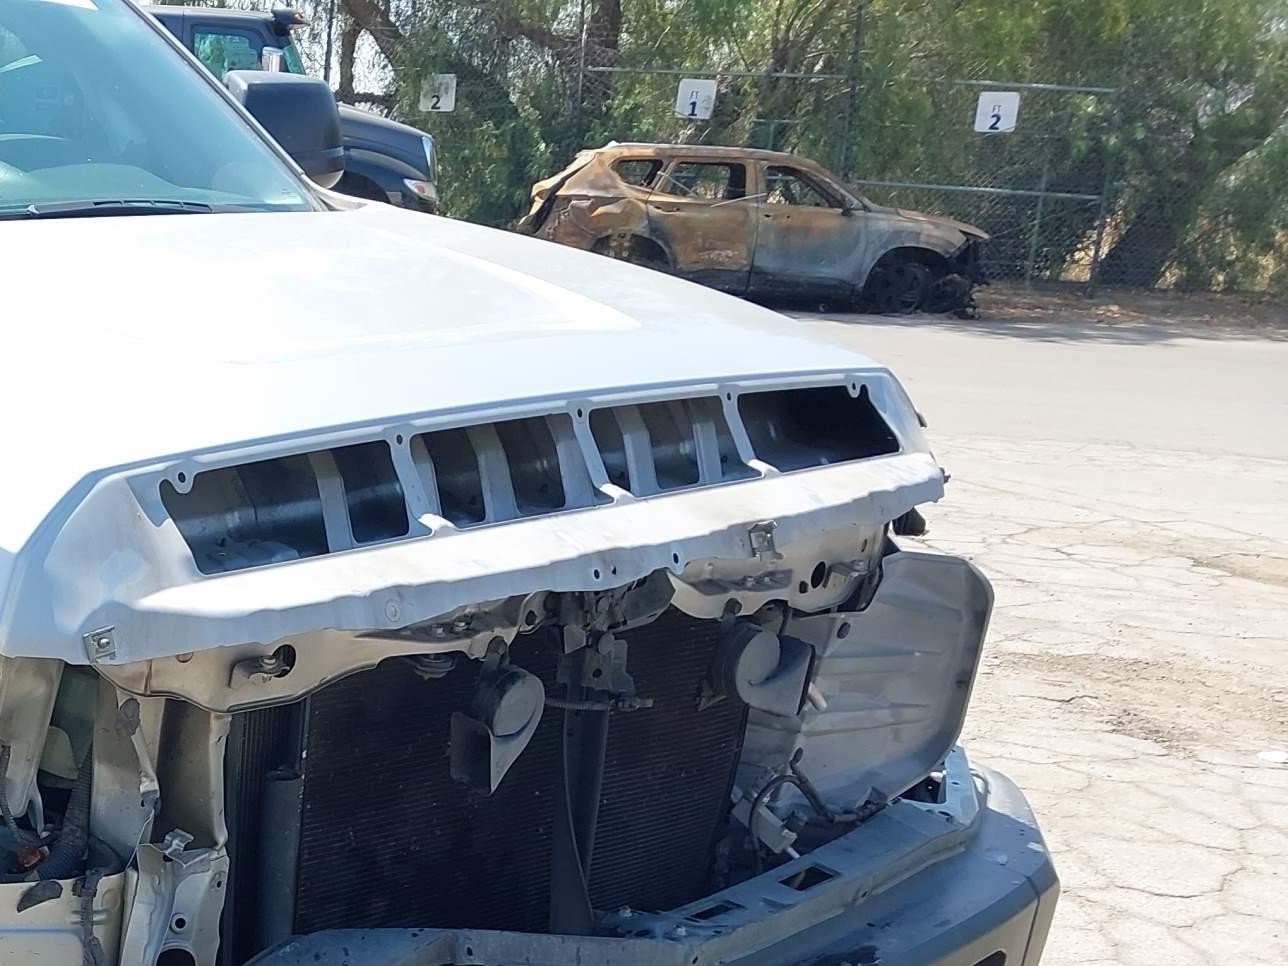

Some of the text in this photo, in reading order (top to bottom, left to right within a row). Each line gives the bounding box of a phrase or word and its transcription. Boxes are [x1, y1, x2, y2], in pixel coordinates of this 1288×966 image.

[431, 95, 441, 110] 2
[687, 101, 698, 117] 1
[988, 113, 1002, 130] 2
